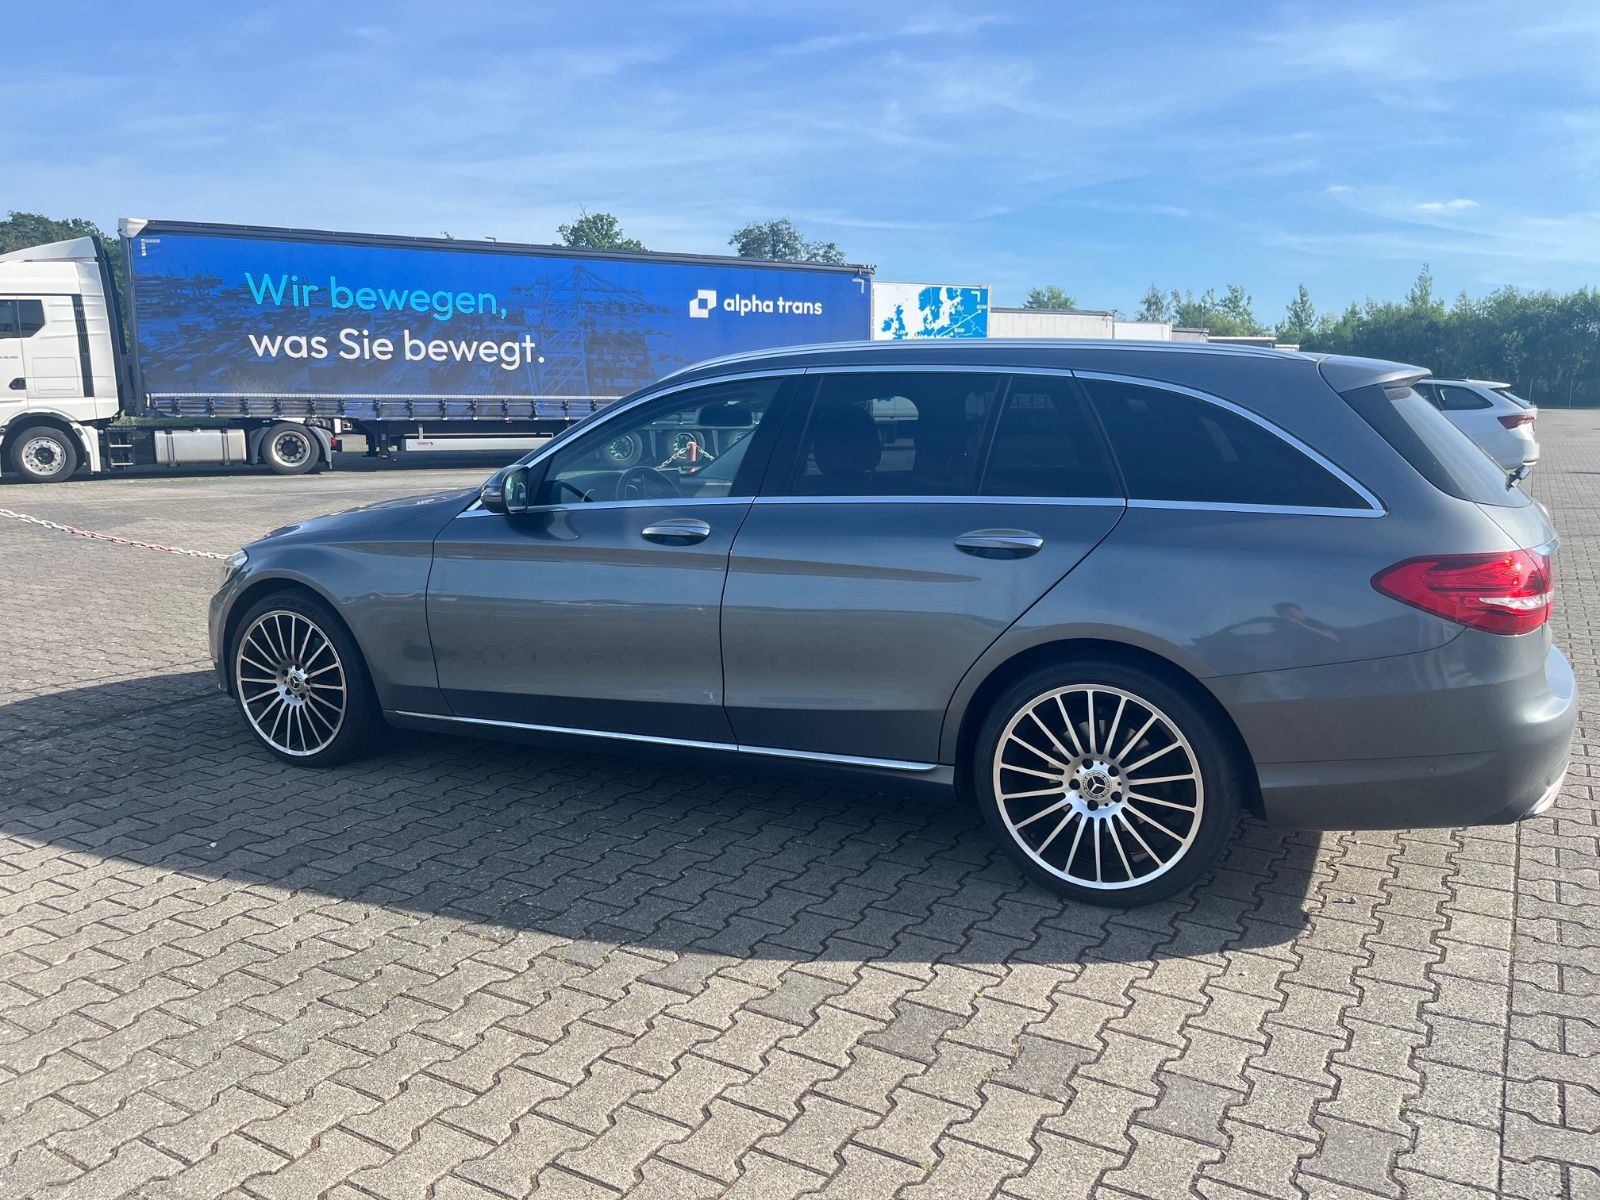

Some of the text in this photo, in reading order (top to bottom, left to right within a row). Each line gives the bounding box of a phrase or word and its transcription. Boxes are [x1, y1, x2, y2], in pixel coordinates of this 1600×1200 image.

[244, 272, 508, 321] Wir bewegen,
[723, 293, 823, 317] alpha trans
[248, 328, 545, 371] was Sie bewegt.
